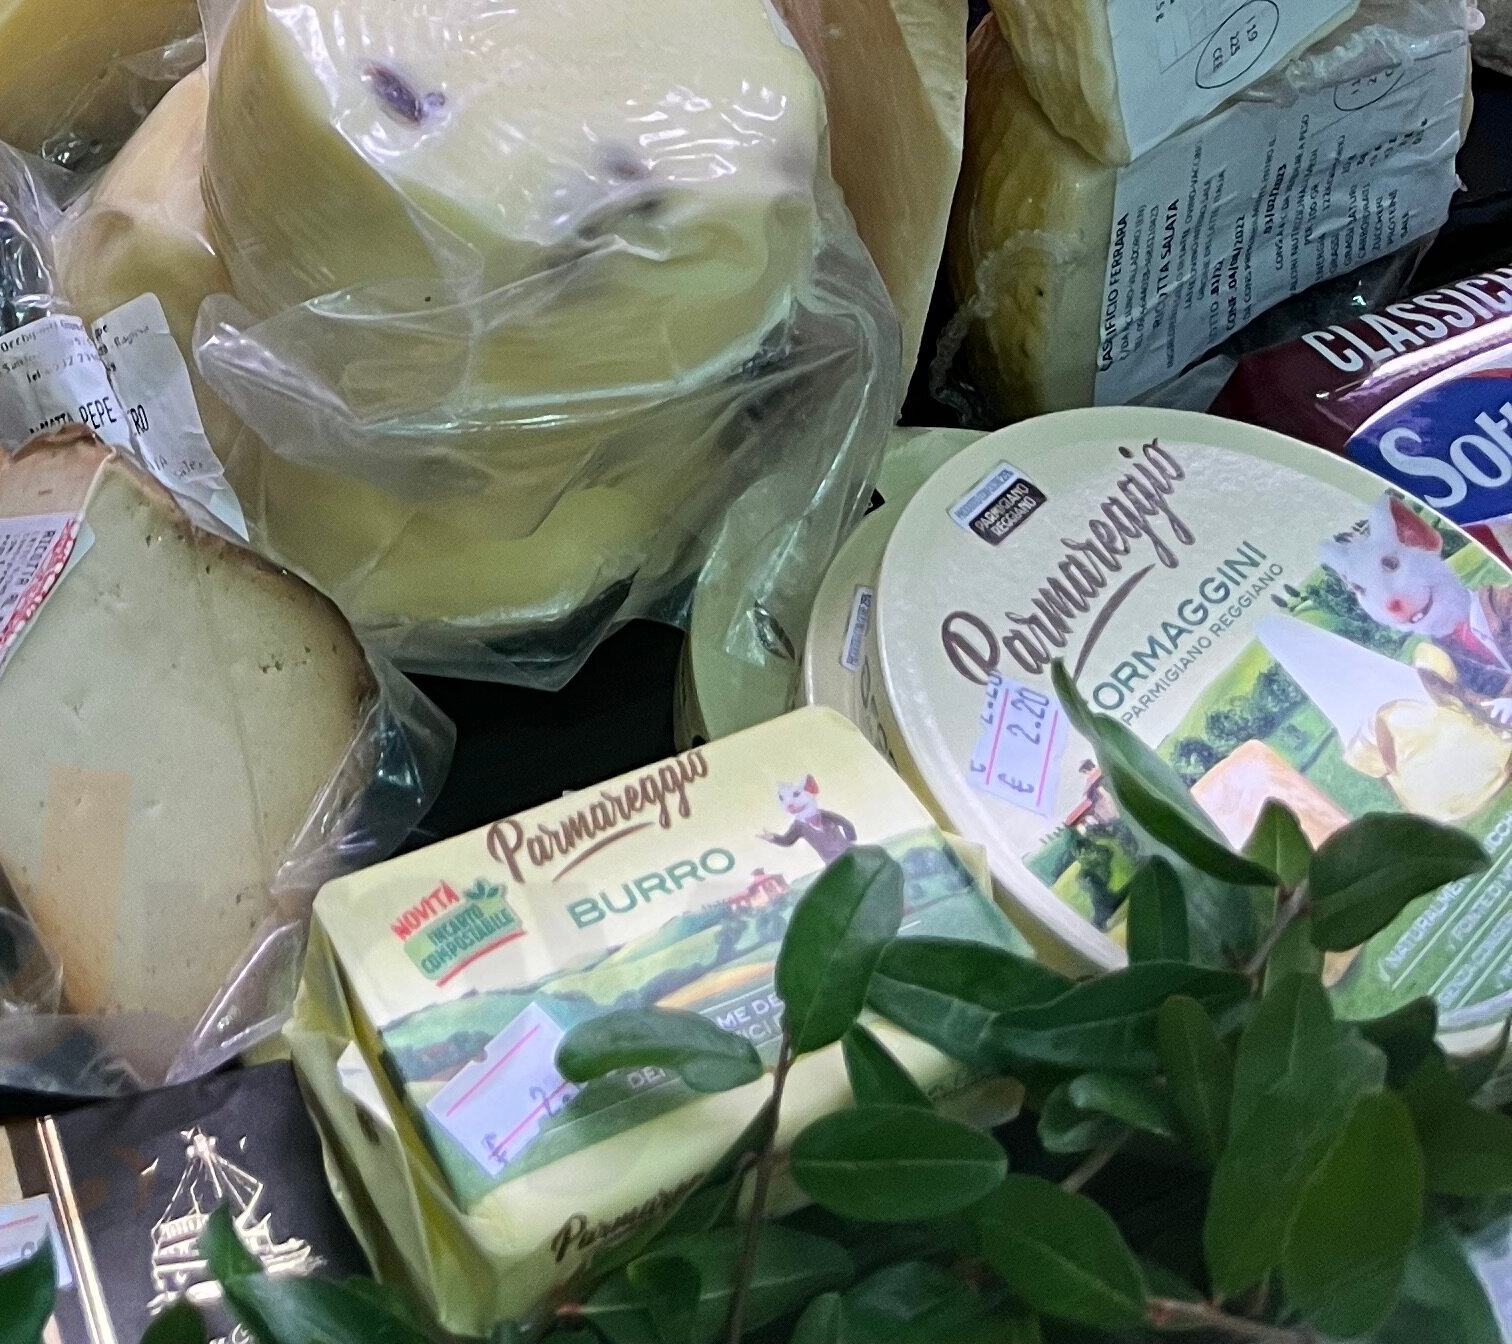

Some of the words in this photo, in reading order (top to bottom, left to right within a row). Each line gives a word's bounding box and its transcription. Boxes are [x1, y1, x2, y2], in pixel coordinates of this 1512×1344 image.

[1108, 210, 1129, 287] FERRARA
[1160, 196, 1179, 260] SALATA
[78, 396, 118, 430] PEPE
[125, 403, 150, 436] RO
[940, 437, 1197, 686] Parmareggio
[1092, 539, 1268, 711] ORMAGGINI
[1120, 634, 1213, 728] PARMIGIANO
[1208, 562, 1285, 639] REGGIANO
[1005, 685, 1051, 746] 2.20
[488, 747, 710, 884] Parmareggio
[566, 846, 737, 930] BURRO
